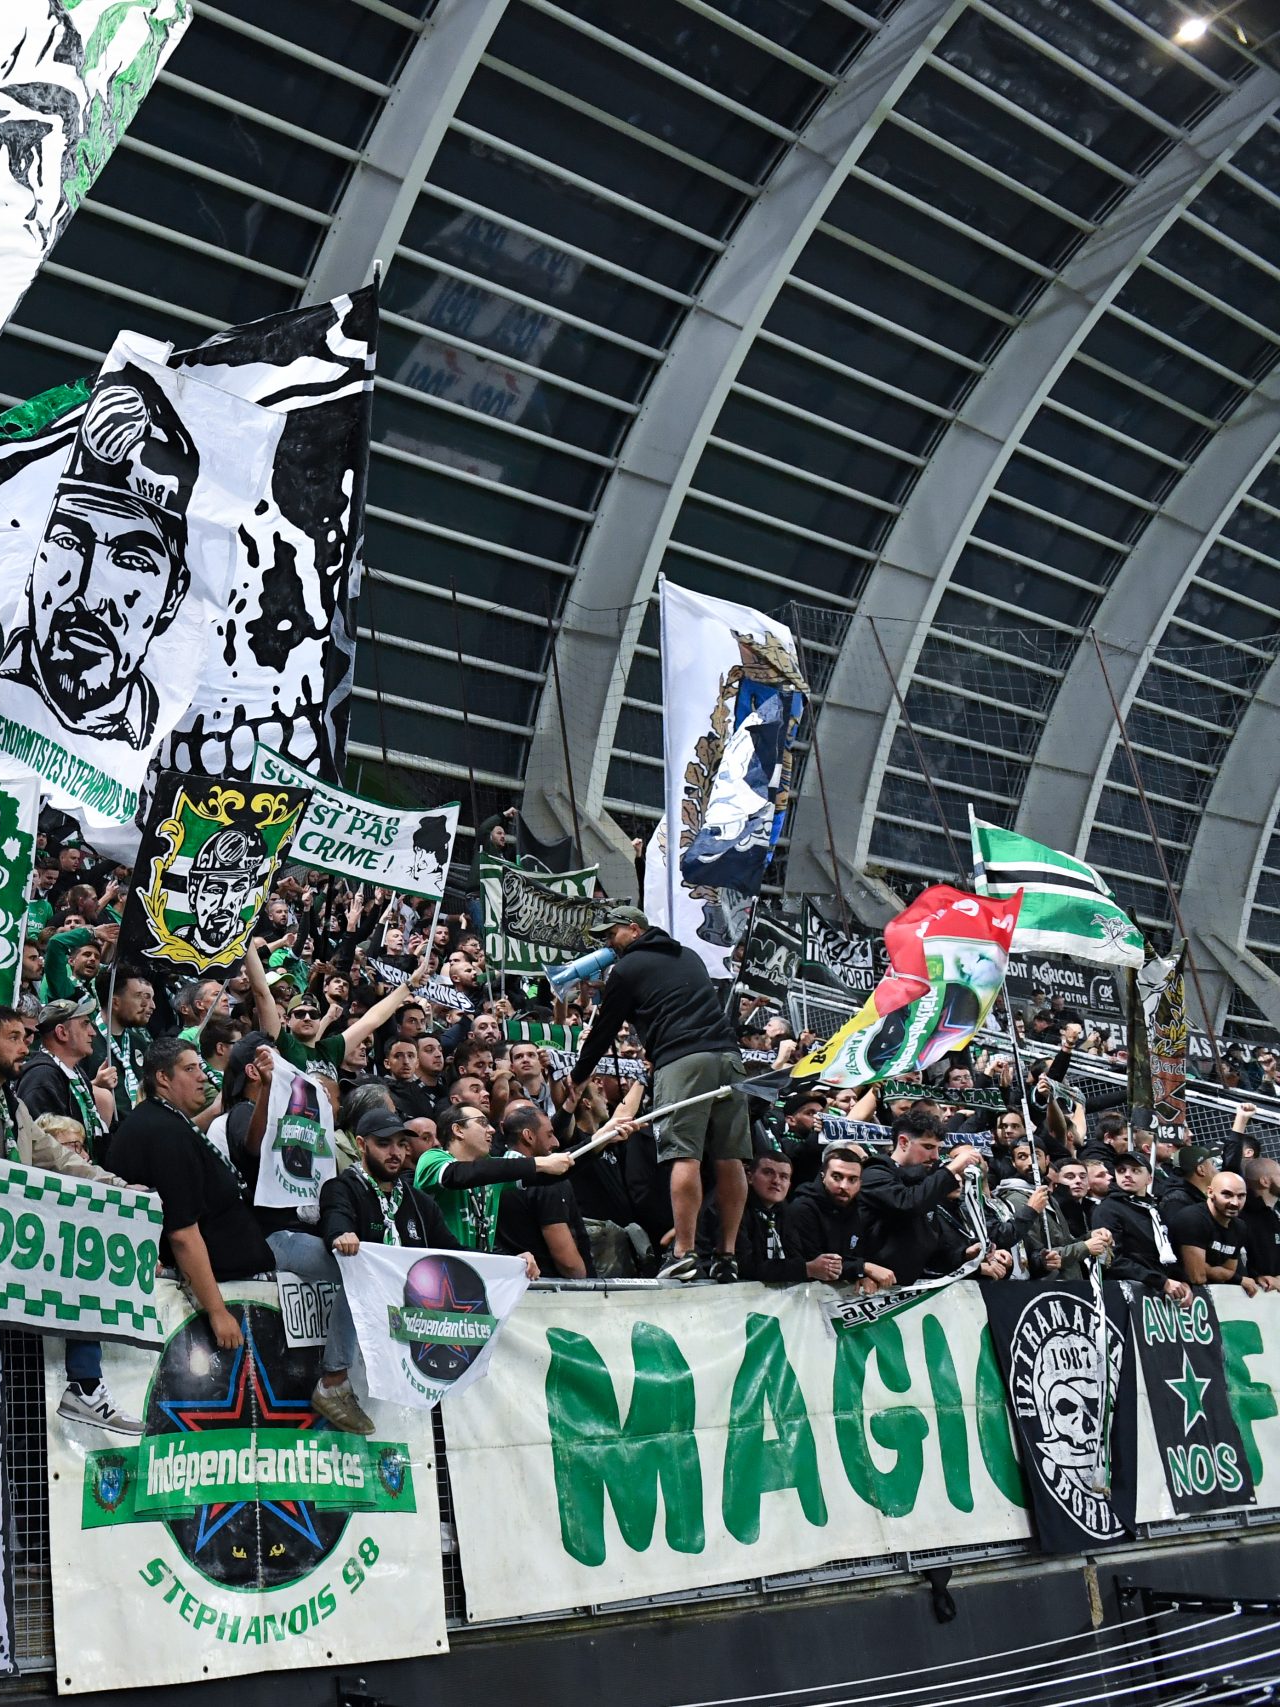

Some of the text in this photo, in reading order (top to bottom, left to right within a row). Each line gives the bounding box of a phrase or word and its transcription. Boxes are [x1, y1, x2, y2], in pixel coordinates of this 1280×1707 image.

[299, 831, 383, 871] CRIME
[345, 818, 399, 846] PAS
[1032, 964, 1085, 988] AGRICOLE
[1142, 1296, 1213, 1346] AVEC
[1050, 1346, 1093, 1371] 1987
[146, 1432, 366, 1497] Indépendantistes
[1167, 1443, 1245, 1497] NOS
[139, 1536, 381, 1646] STEPHANOIS 98
